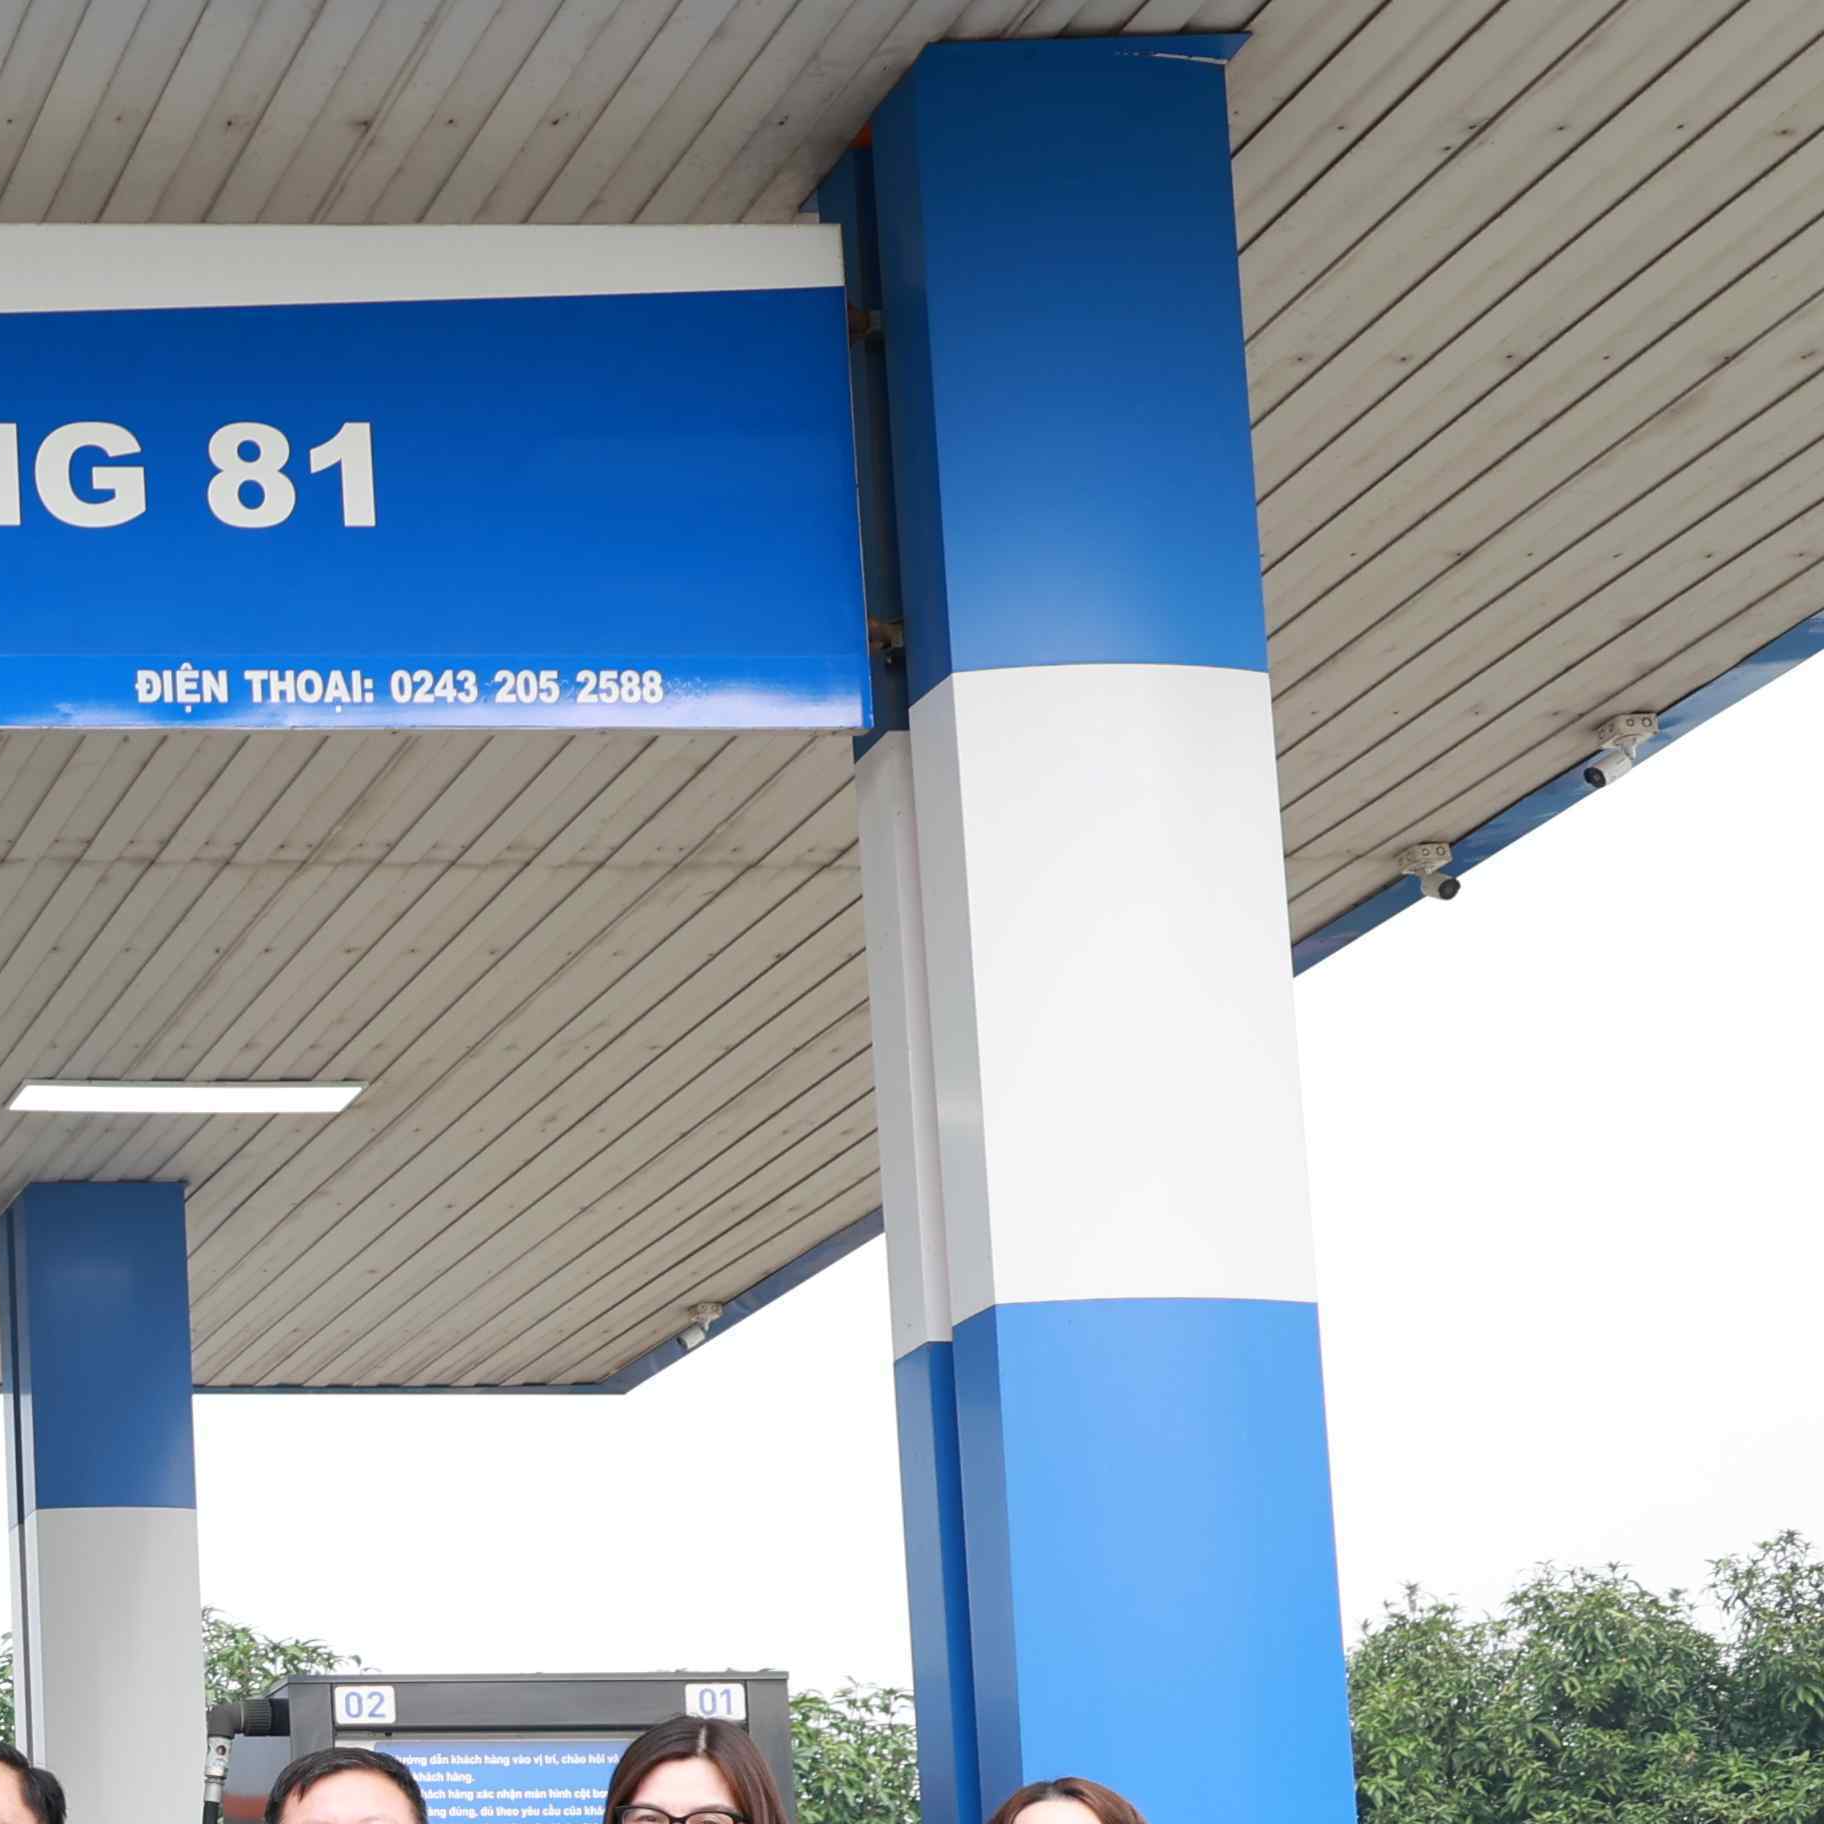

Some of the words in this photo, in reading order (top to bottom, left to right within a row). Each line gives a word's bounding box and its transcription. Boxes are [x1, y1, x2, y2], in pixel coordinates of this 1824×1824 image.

[207, 422, 376, 529] 81
[136, 663, 228, 713] ĐIỆN
[245, 669, 374, 713] THOẠI:
[391, 669, 479, 705] 0243
[494, 669, 561, 704] 205
[576, 669, 664, 704] 2588
[344, 1692, 386, 1718] 02
[699, 1688, 731, 1715] 01
[429, 1753, 449, 1765] dẫn
[450, 1754, 482, 1765] khách
[484, 1754, 510, 1766] hàng
[512, 1754, 531, 1765] vào
[561, 1753, 587, 1765] chào
[448, 1789, 474, 1802] hàng
[475, 1789, 496, 1800] xác
[497, 1788, 523, 1801] nhận
[524, 1789, 547, 1800] màn
[548, 1788, 572, 1799] hình
[573, 1788, 591, 1800] cột
[496, 1806, 520, 1817] theo
[521, 1806, 540, 1819] yêu
[542, 1803, 561, 1817] cầu
